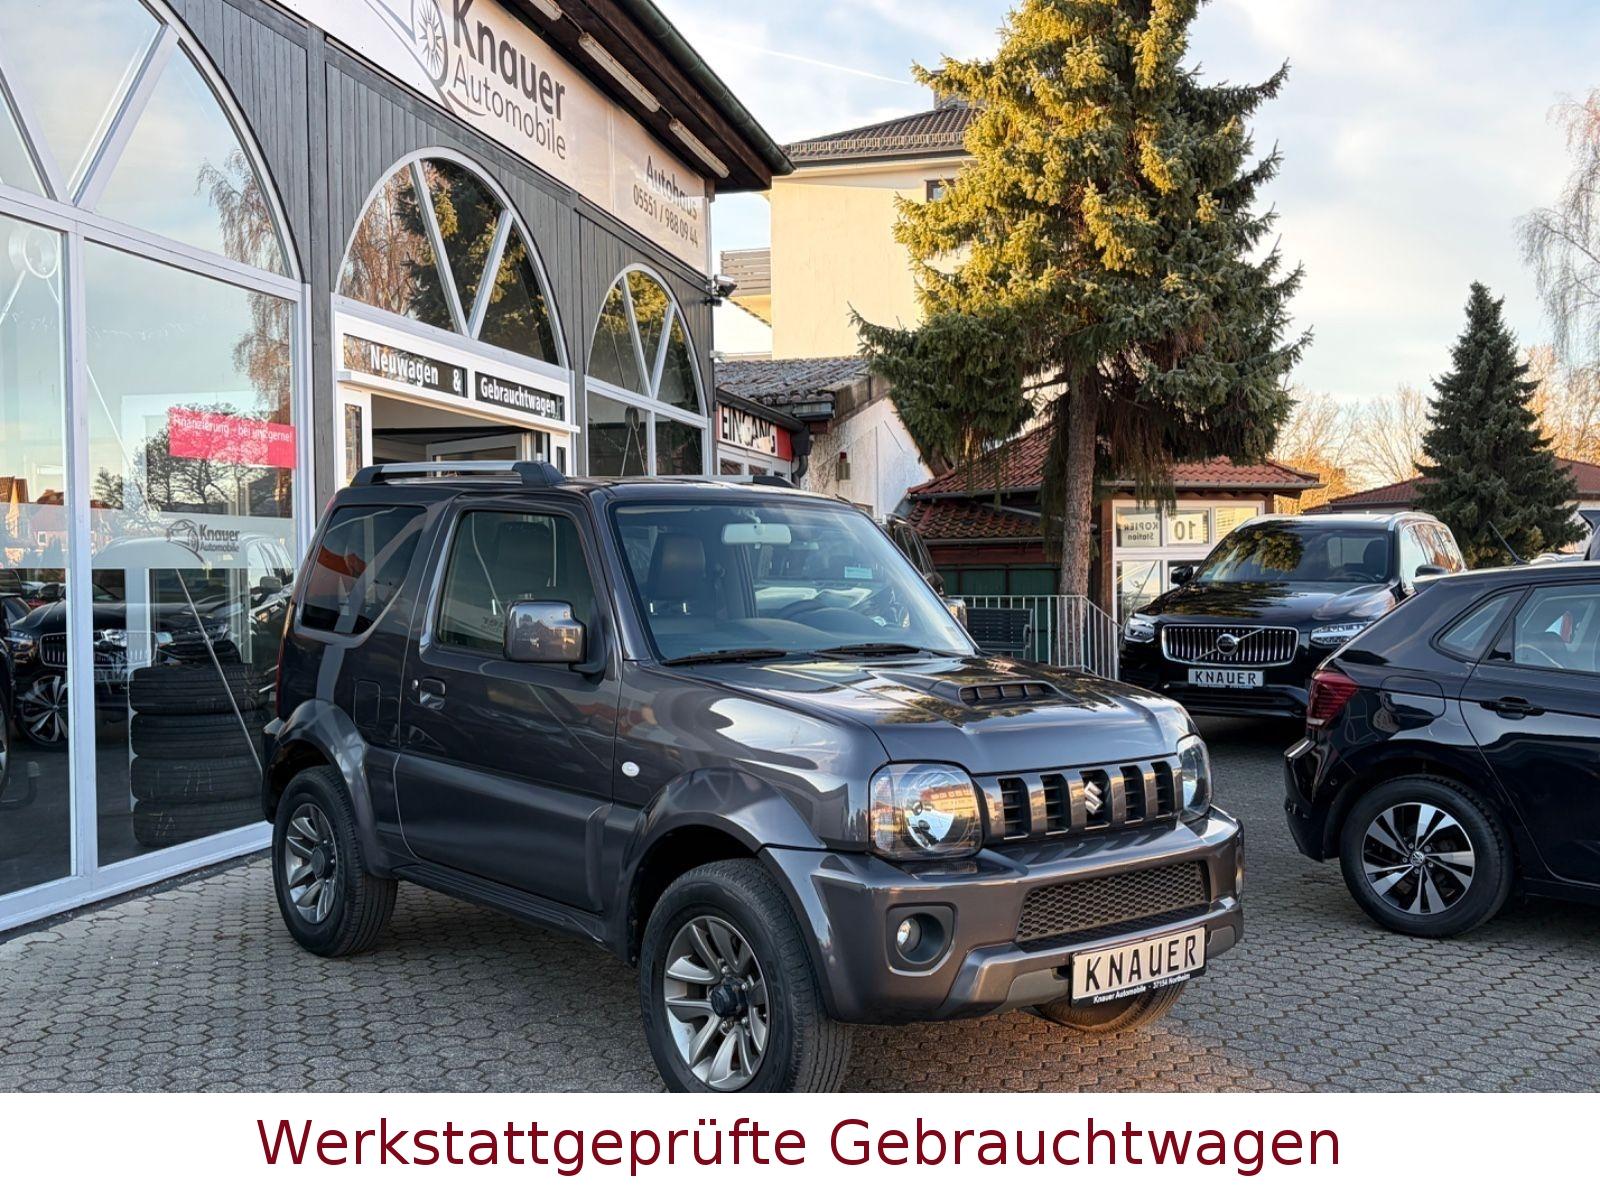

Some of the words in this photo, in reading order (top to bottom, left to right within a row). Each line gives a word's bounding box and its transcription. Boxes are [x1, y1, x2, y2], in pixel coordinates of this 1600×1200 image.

[453, 0, 566, 121] Knauer
[453, 54, 567, 160] Automobile
[633, 184, 658, 220] 05551
[665, 208, 679, 234] 988
[646, 155, 698, 220] Autohaus
[370, 345, 438, 387] Neuwagen
[453, 369, 461, 392] &
[480, 376, 556, 417] Gebrauchtwagen
[268, 432, 293, 443] gerne!
[199, 524, 240, 541] Knauer
[199, 541, 240, 552] Automobile
[1195, 670, 1256, 685] KNAUER
[1086, 935, 1196, 992] KNAUER
